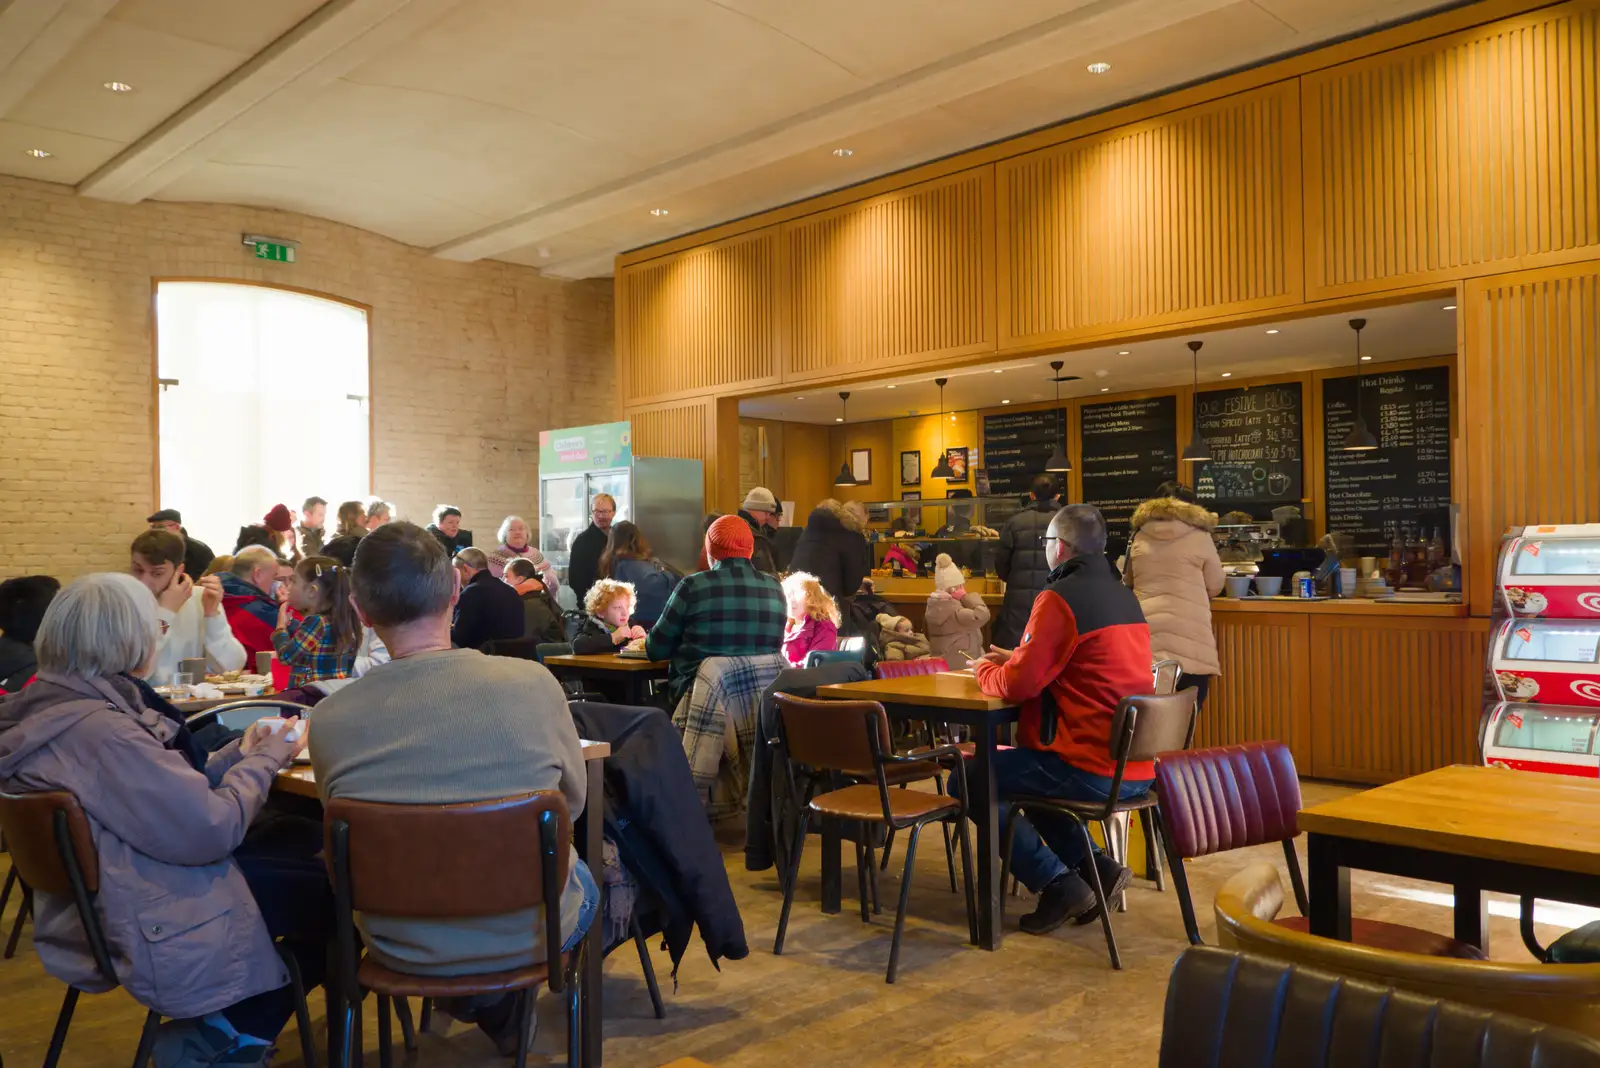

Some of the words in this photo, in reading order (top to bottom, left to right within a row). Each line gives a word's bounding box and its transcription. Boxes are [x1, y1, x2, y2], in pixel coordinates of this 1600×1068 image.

[1361, 379, 1377, 388] Hot
[1378, 376, 1406, 386] Drinks
[1224, 394, 1257, 413] FESTIVE
[1329, 491, 1341, 499] Hot
